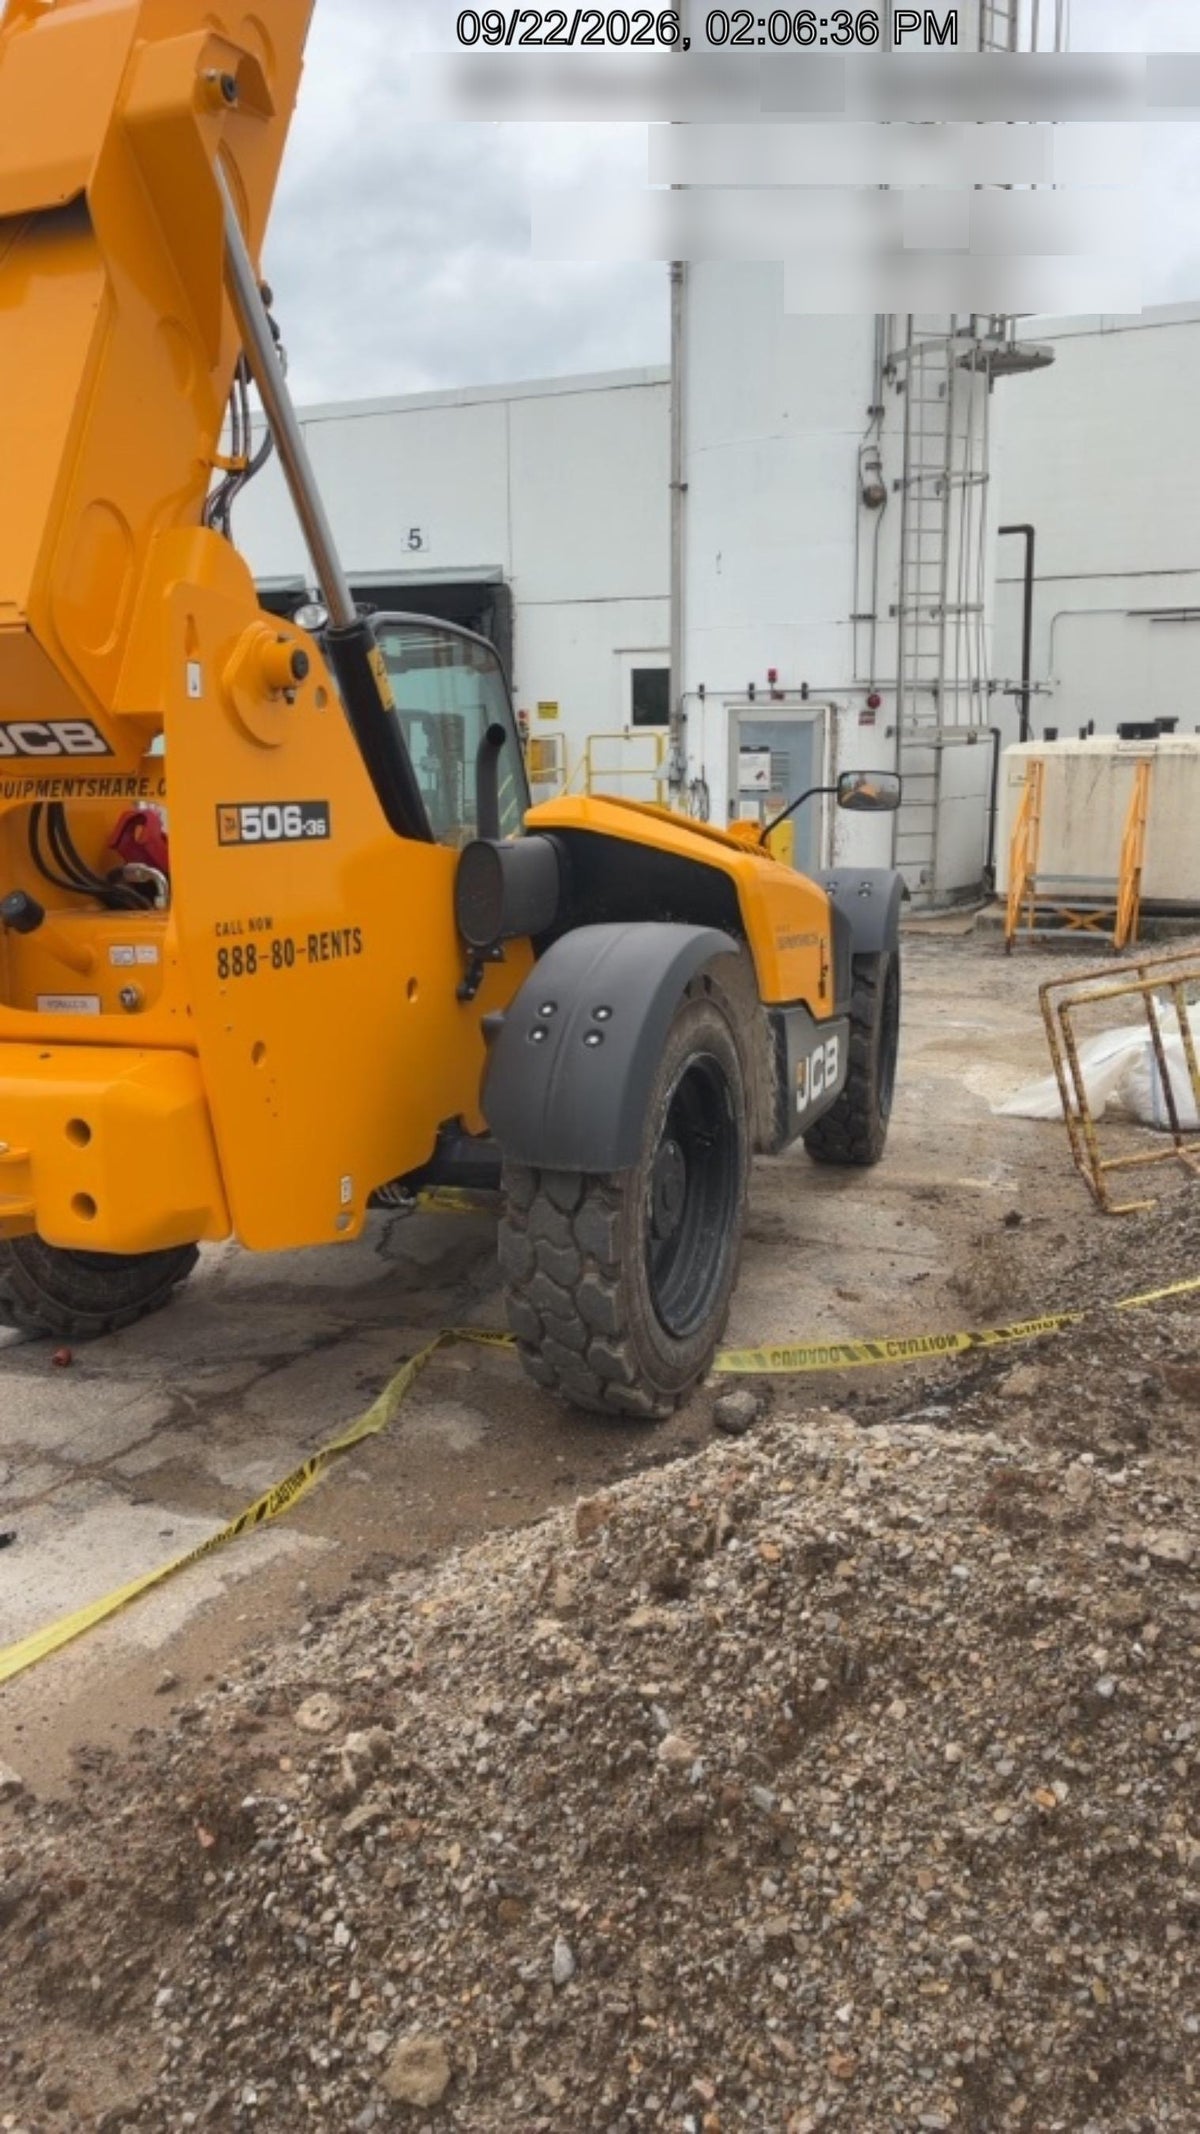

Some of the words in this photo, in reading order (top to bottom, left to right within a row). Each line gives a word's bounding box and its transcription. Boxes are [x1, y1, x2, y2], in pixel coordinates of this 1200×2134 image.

[407, 528, 423, 550] 5
[215, 920, 243, 937] CALL
[248, 917, 273, 931] NOW
[217, 926, 362, 980] 888-80-RENTS
[796, 1035, 839, 1113] JCB
